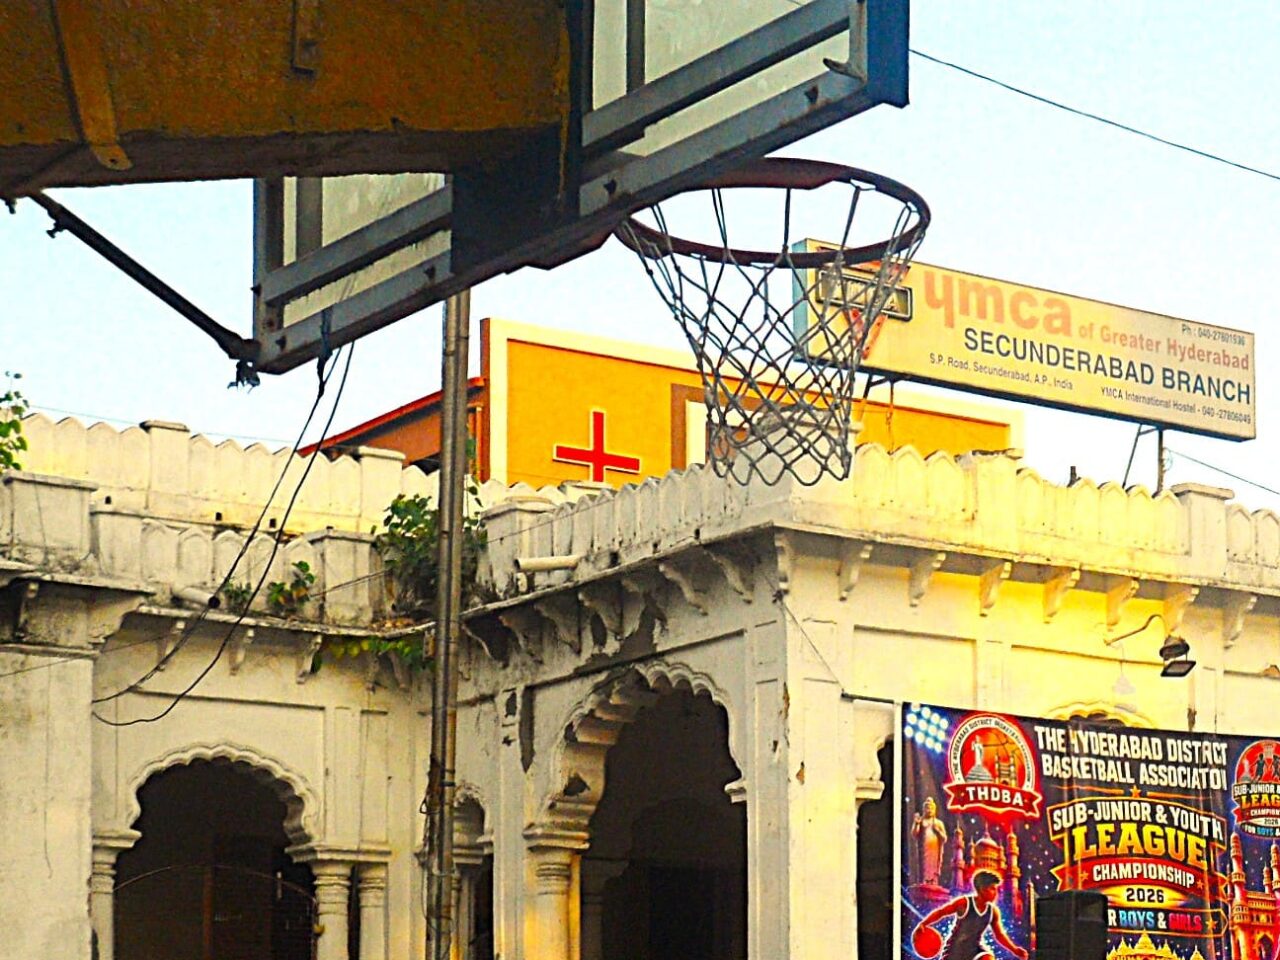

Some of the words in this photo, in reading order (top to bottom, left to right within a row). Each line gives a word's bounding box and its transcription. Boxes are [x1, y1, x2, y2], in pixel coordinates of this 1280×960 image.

[923, 270, 1073, 337] ymca
[1079, 321, 1095, 339] of
[1100, 325, 1161, 354] Greater
[1167, 337, 1249, 370] Hyderabad
[964, 327, 1154, 385] SECUNDERABAD
[1162, 367, 1250, 405] BRANCH
[1054, 377, 1073, 391] India
[1101, 386, 1123, 401] YMCA
[1126, 390, 1171, 410] International
[1173, 400, 1196, 414] Hostel
[1034, 725, 1067, 753] THE
[1069, 728, 1162, 761] HYDERABAD
[1041, 753, 1136, 784] BASKETBALL
[966, 786, 1024, 807] THDBA
[1234, 783, 1275, 796] SUB-JUNIOR
[1052, 800, 1152, 832] SUB-JUNIOR
[1155, 804, 1168, 824] &
[1170, 806, 1224, 841] YOUTH
[1071, 822, 1208, 870] LEAGUE
[1092, 862, 1195, 889] CHAMPIONSHIP
[1126, 887, 1165, 904] 2026
[1119, 909, 1156, 929] BOYS
[1157, 910, 1168, 930] &
[1168, 912, 1203, 932] GIRLS
